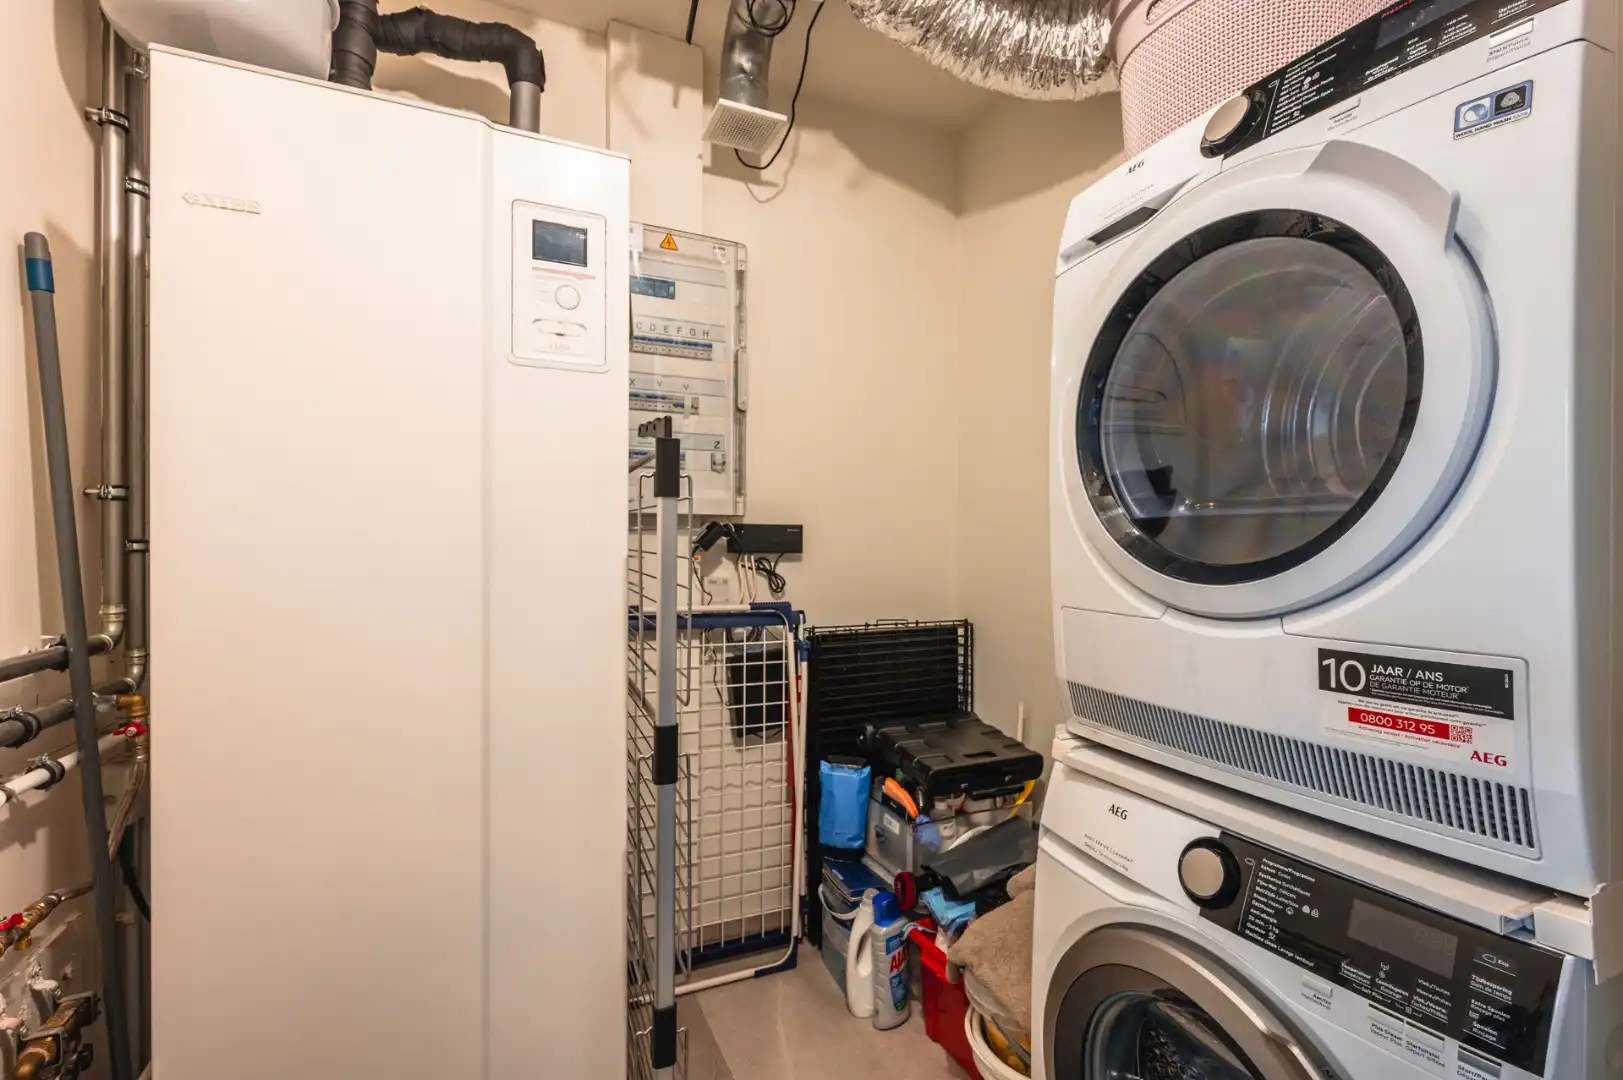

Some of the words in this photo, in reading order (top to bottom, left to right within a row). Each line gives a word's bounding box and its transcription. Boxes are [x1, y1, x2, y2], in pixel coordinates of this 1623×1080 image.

[1126, 160, 1145, 175] AEG
[702, 330, 710, 338] H
[714, 440, 720, 450] Z
[1322, 657, 1367, 692] 10
[1370, 664, 1404, 677] JAAR
[1415, 670, 1444, 682] ANS
[1369, 674, 1408, 686] GARANTIE
[1422, 681, 1434, 690] DE
[1369, 680, 1380, 688] DE
[1381, 682, 1420, 694] GARANTIE
[1360, 712, 1393, 727] 0800
[1396, 719, 1416, 732] 312
[1420, 723, 1436, 735] 95
[1470, 750, 1507, 767] AEG
[1108, 804, 1128, 820] AEG
[1498, 959, 1511, 968] Eco
